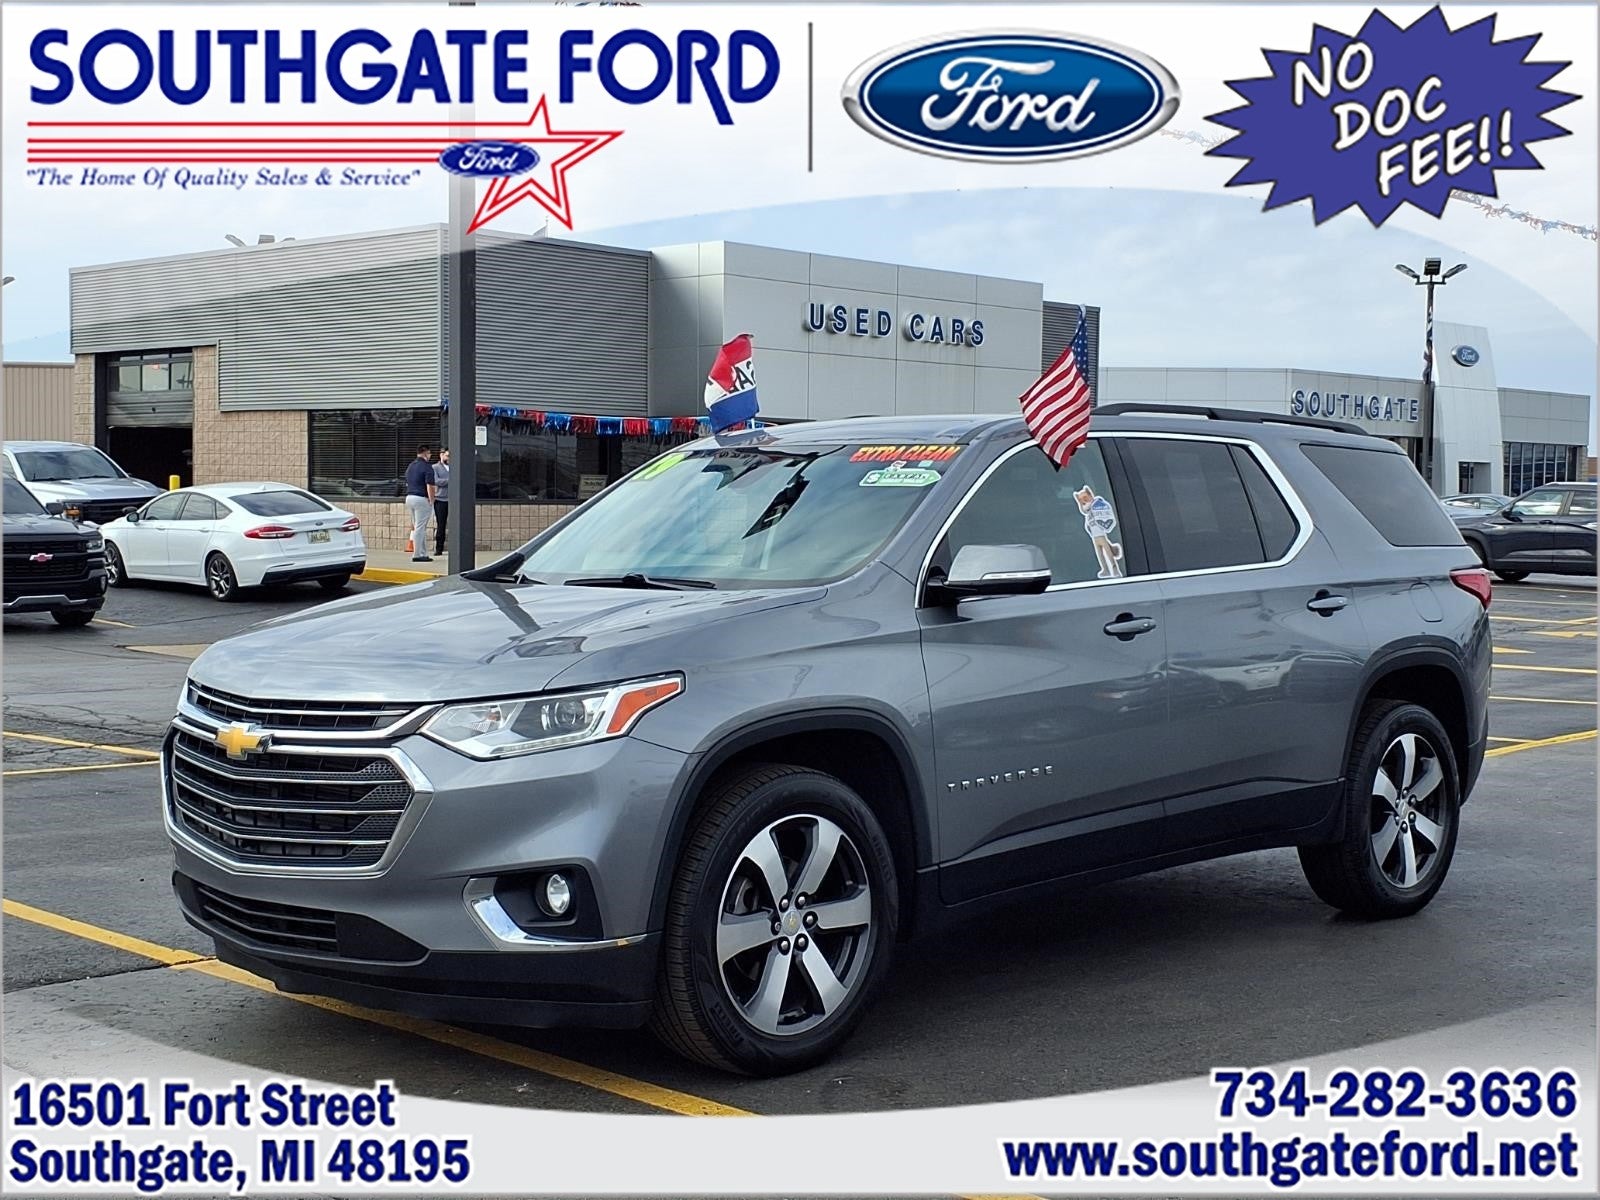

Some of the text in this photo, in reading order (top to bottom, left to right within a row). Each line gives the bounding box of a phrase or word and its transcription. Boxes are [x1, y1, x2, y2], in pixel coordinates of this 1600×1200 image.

[806, 302, 986, 347] USED CARS
[1291, 389, 1419, 422] SOUTHGATE
[849, 444, 960, 462] EXTRA CLEAN
[946, 765, 1053, 793] TRAVERSE
